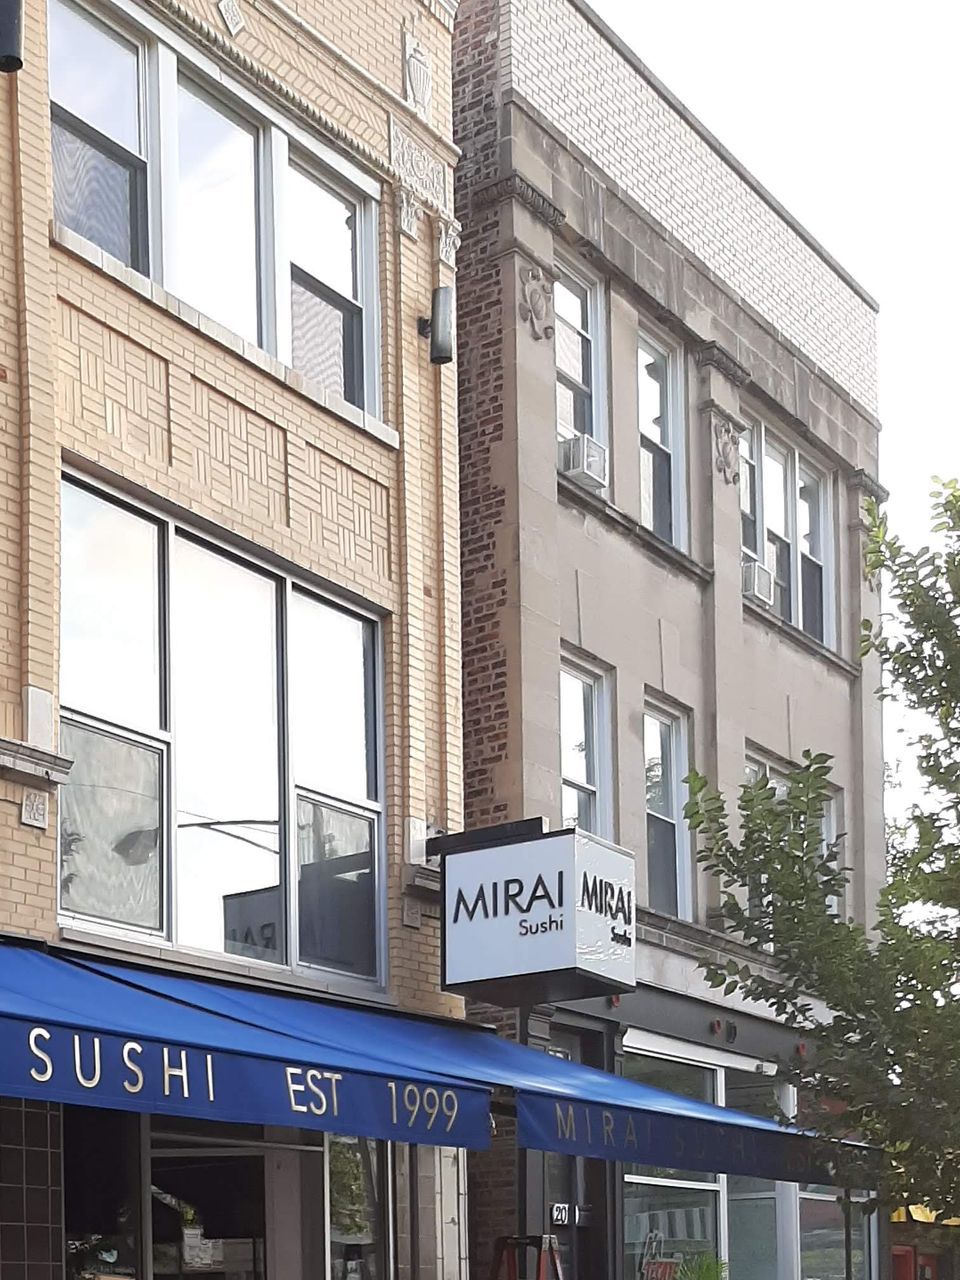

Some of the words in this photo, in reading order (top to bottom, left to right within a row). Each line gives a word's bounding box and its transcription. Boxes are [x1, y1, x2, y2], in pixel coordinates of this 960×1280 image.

[452, 870, 564, 924] MIRAI
[581, 870, 632, 926] MIRAI
[518, 913, 564, 936] Sushi
[28, 1026, 216, 1102] SUSHI
[284, 1066, 343, 1117] EST
[386, 1080, 459, 1133] 1999
[554, 1102, 652, 1150] MIRAI
